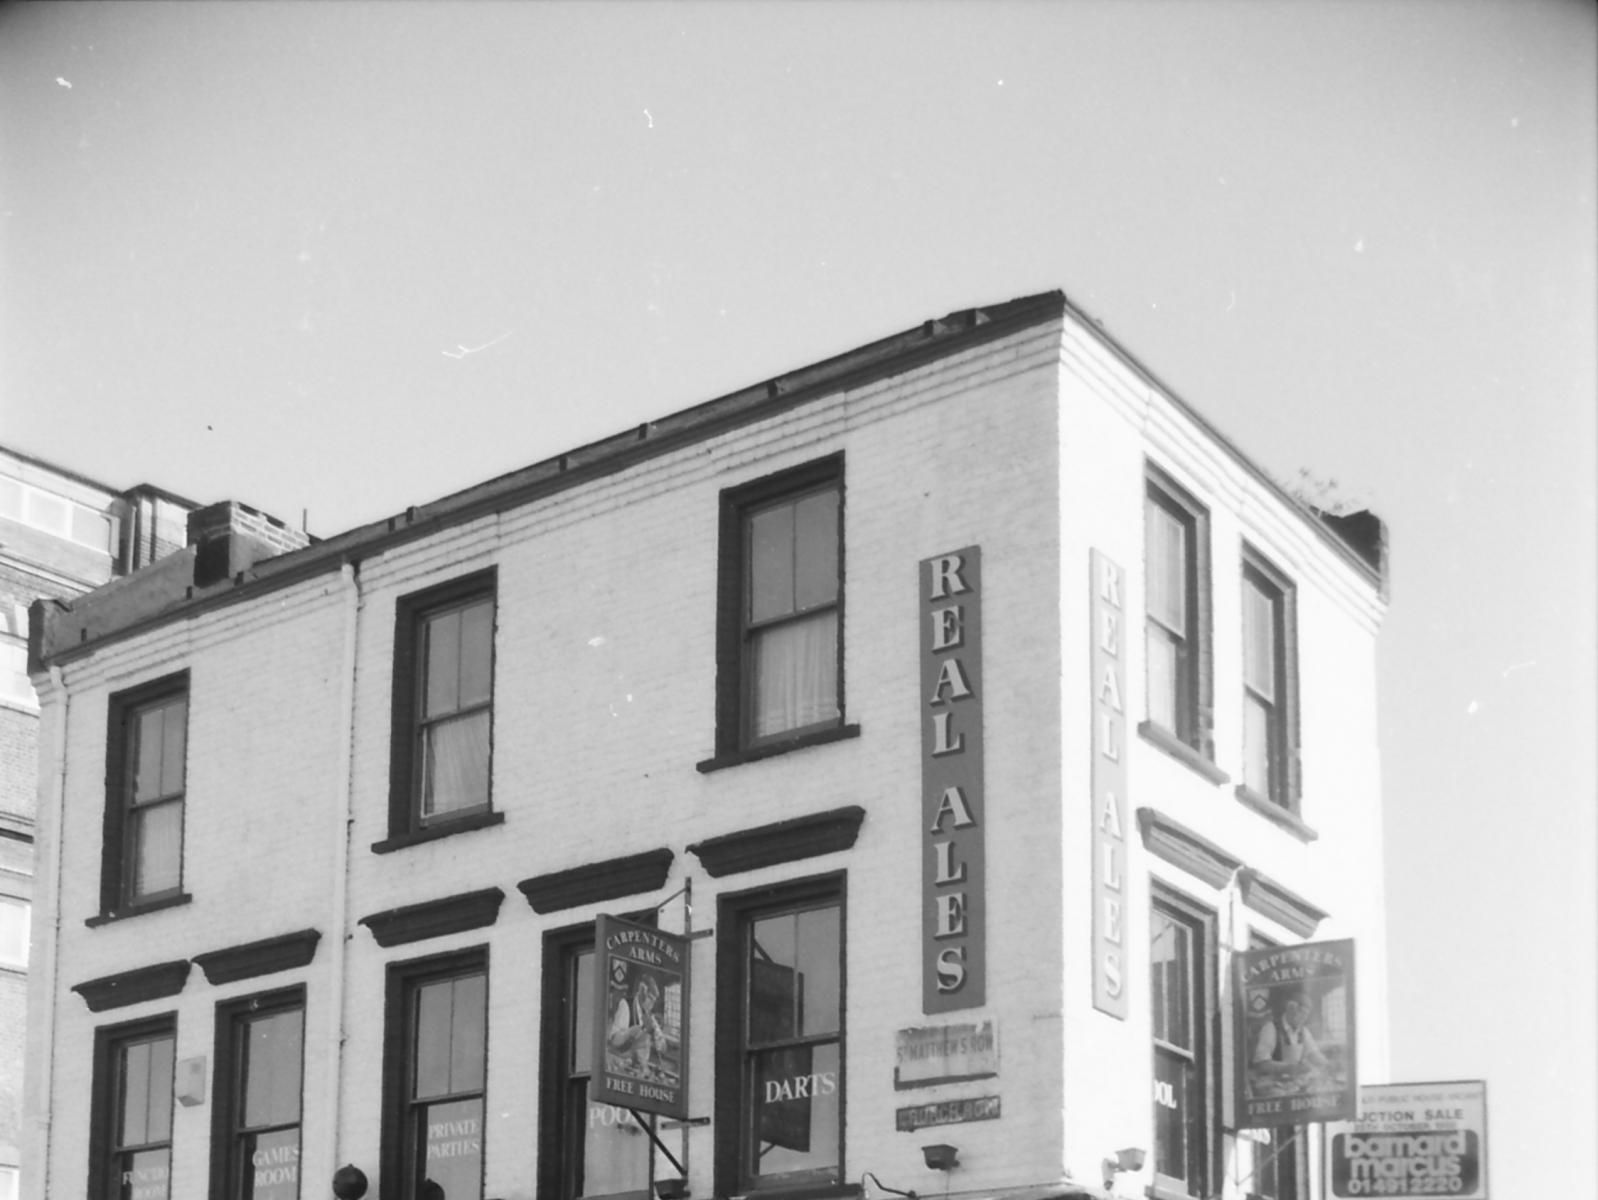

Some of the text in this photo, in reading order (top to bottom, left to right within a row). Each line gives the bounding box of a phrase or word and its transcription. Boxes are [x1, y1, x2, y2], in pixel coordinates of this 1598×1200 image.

[930, 553, 972, 993] REAL ALES
[1098, 555, 1122, 1000] REAL ALES
[606, 929, 680, 963] CARPENTERS
[630, 946, 662, 965] ARMS
[606, 1077, 675, 1103] FREE HOUSE
[764, 1071, 836, 1104] DARTS
[1358, 1108, 1464, 1123] UCTION SALE
[252, 1144, 300, 1167] GAMES
[1351, 1155, 1462, 1179] marcus
[255, 1166, 297, 1187] ROOM
